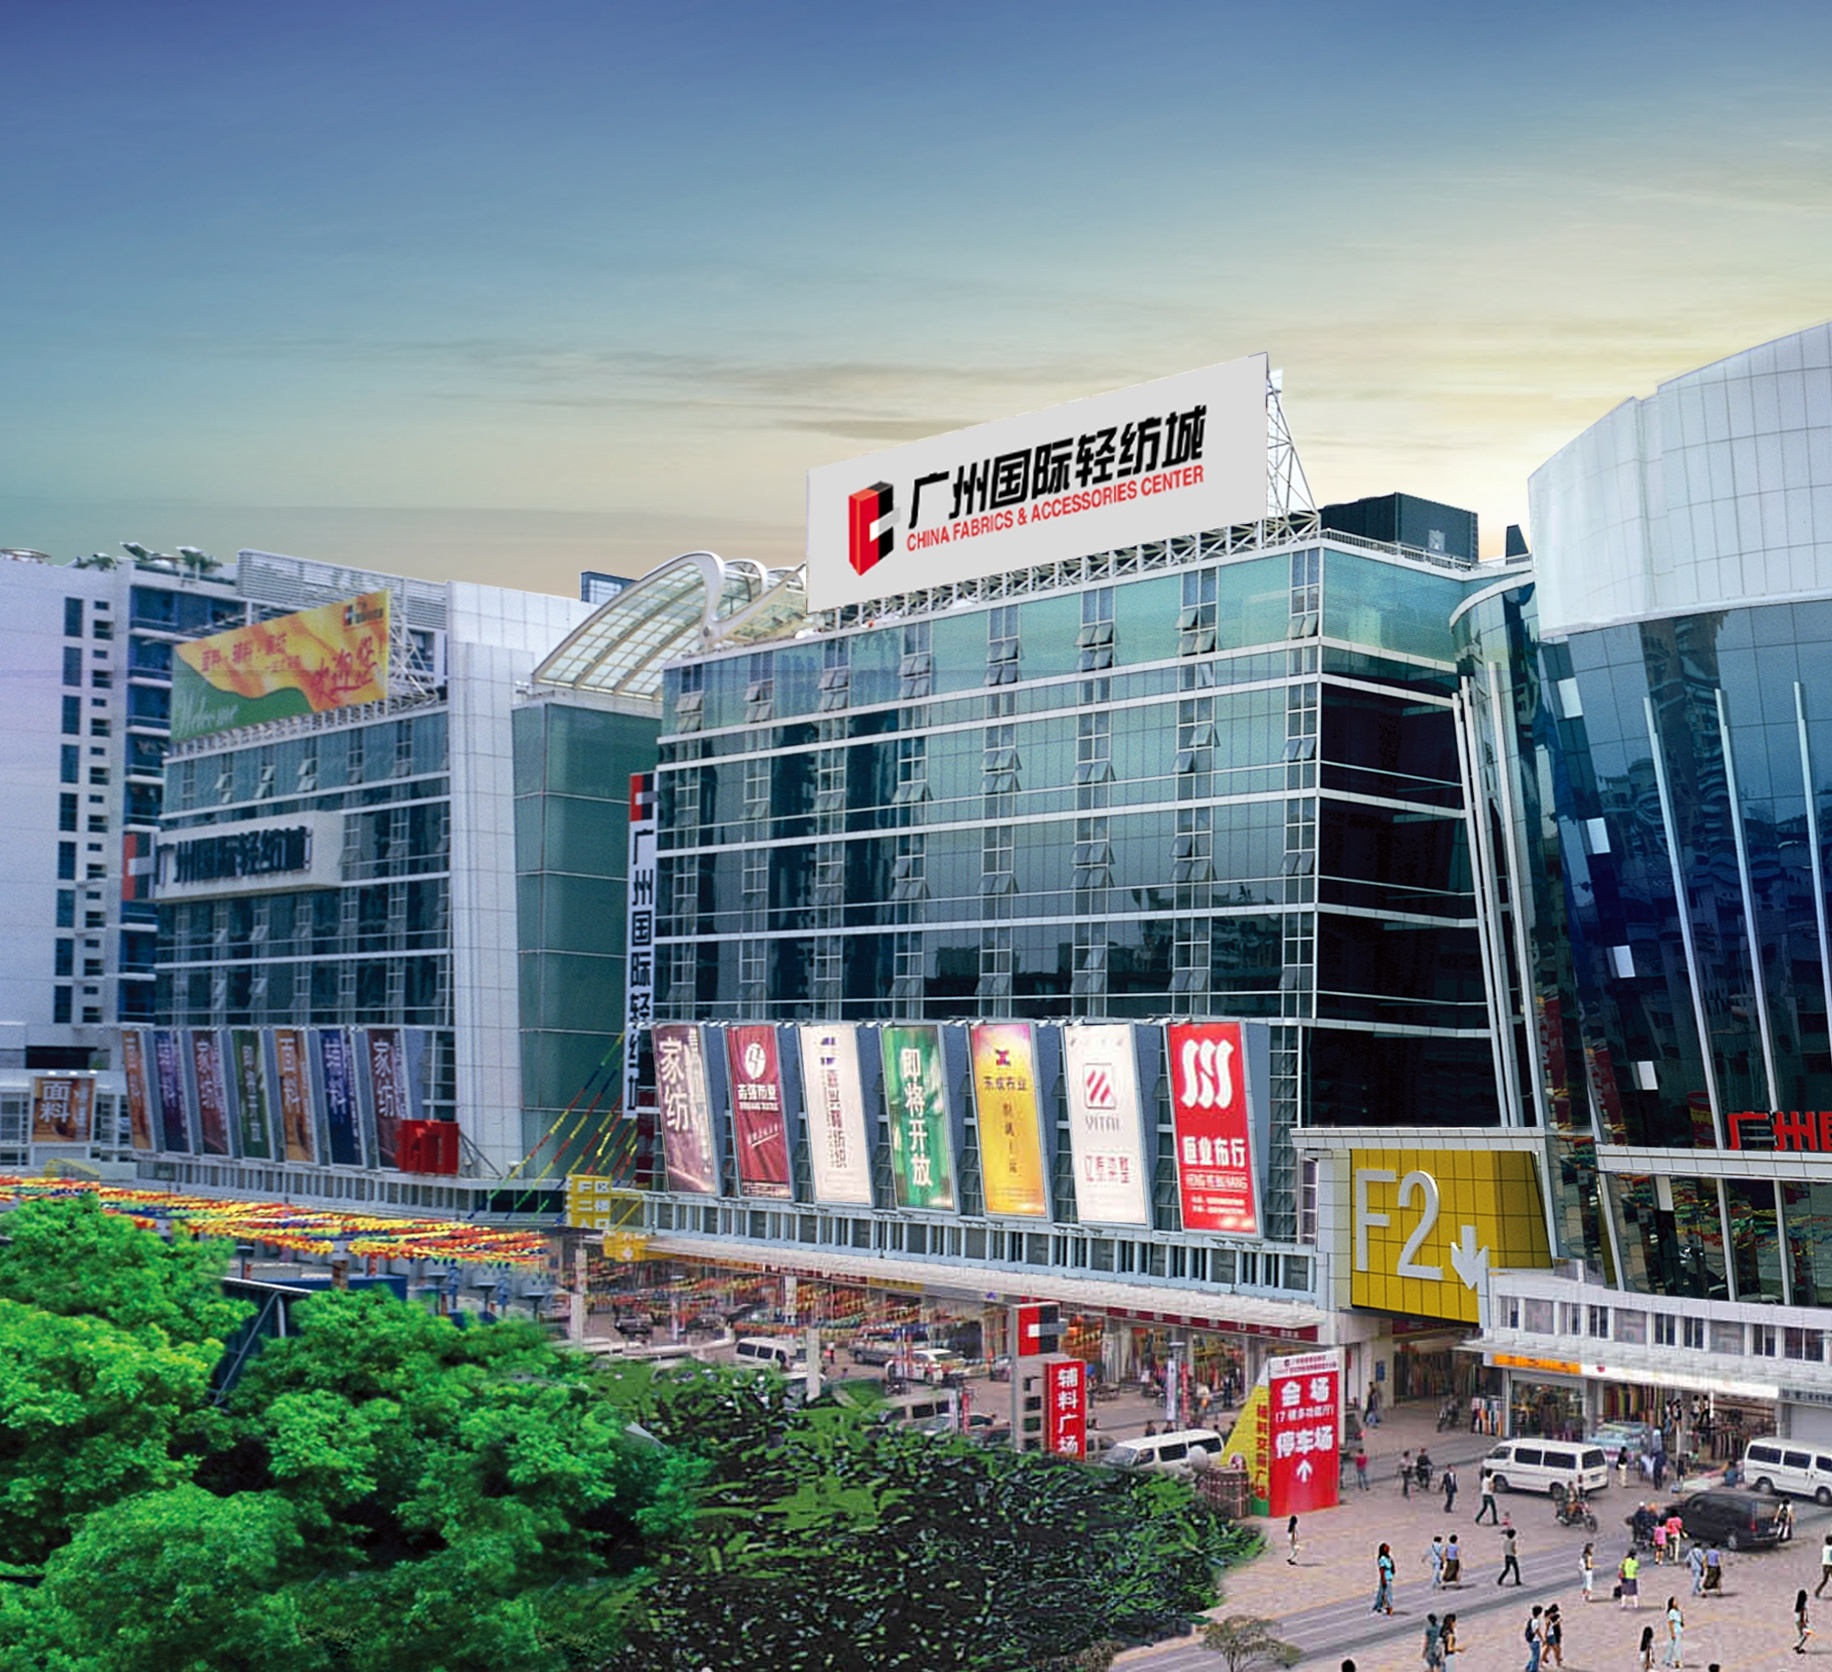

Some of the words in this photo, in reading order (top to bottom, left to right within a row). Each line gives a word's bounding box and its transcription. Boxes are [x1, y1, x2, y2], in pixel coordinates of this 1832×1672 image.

[906, 526, 950, 551] CHINA
[953, 508, 1013, 541] FABRICS
[1017, 508, 1027, 526] &
[1031, 483, 1137, 522] ACCESSORIES
[1141, 465, 1204, 497] CENTER
[907, 405, 1208, 530] 广州国际轻纺城
[39, 1080, 74, 1124] 面料
[373, 1038, 395, 1118] 家纺
[659, 1036, 691, 1133] 家纺
[901, 1049, 933, 1188] 即将开放
[1355, 1168, 1444, 1281] F2
[1057, 1367, 1079, 1456] 辅料广场
[1281, 1377, 1330, 1408] 会场
[1275, 1425, 1334, 1459] 停车场
